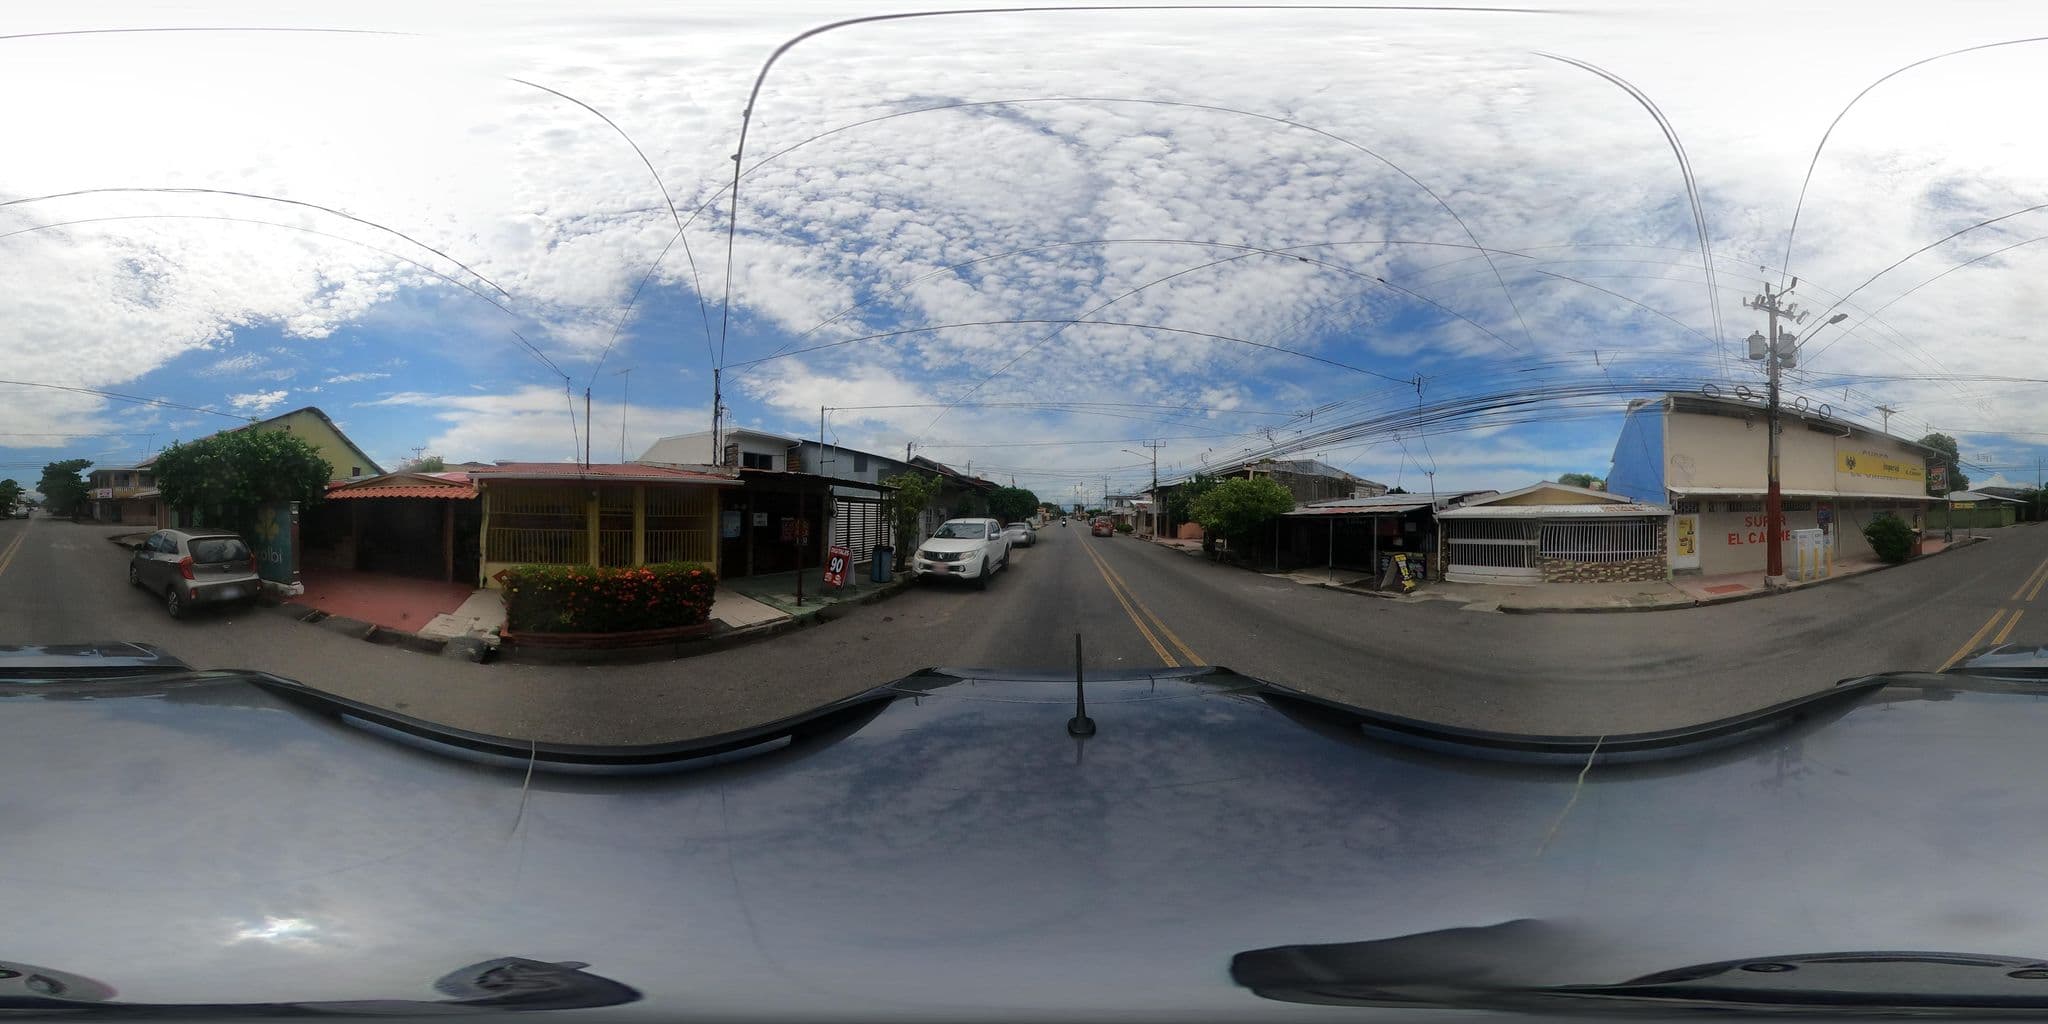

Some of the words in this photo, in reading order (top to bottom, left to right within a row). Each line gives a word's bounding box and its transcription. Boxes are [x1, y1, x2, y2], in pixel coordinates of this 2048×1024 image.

[1745, 516, 1785, 527] SUPR
[1728, 533, 1743, 545] EL
[830, 557, 843, 573] 90
